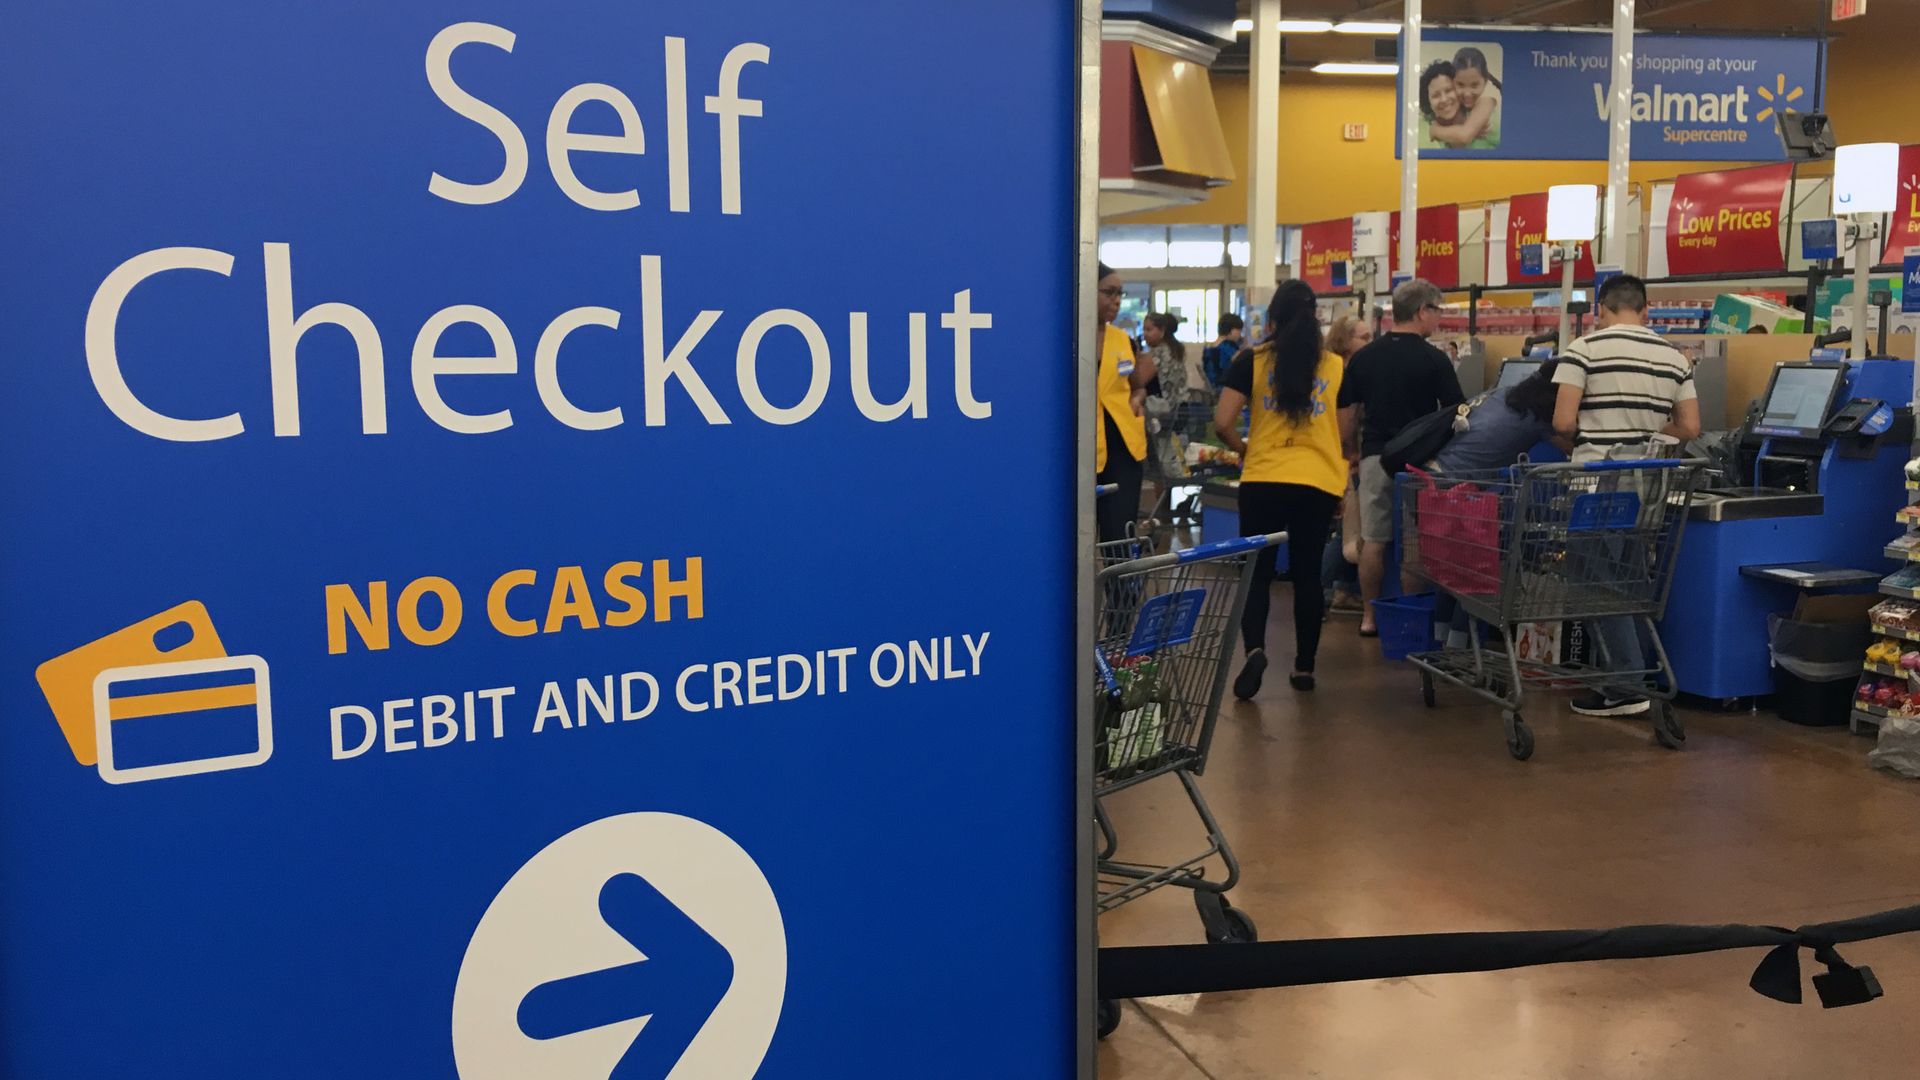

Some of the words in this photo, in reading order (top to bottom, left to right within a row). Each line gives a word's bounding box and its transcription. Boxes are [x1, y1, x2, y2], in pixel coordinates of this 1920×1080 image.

[1531, 51, 1577, 69] Thank
[1580, 55, 1608, 71] you
[1636, 54, 1704, 75] shopping
[1707, 57, 1721, 71] at
[1724, 59, 1758, 75] your
[425, 22, 770, 214] Self
[1349, 124, 1365, 138] EXIT
[1663, 126, 1747, 145] Supercentre
[1679, 213, 1715, 234] Low
[1717, 206, 1772, 232] Prices
[1421, 238, 1454, 257] Prices
[1515, 229, 1542, 250] Low
[1679, 235, 1703, 249] Every
[1703, 233, 1718, 248] day
[1306, 251, 1324, 267] Low
[85, 242, 992, 441] Checkout
[326, 576, 462, 654] NO
[487, 557, 703, 636] CASH
[1569, 620, 1583, 662] FRESH
[330, 687, 515, 759] DEBIT
[533, 672, 659, 732] AND
[676, 647, 856, 712] CREDIT
[870, 632, 989, 687] ONLY
